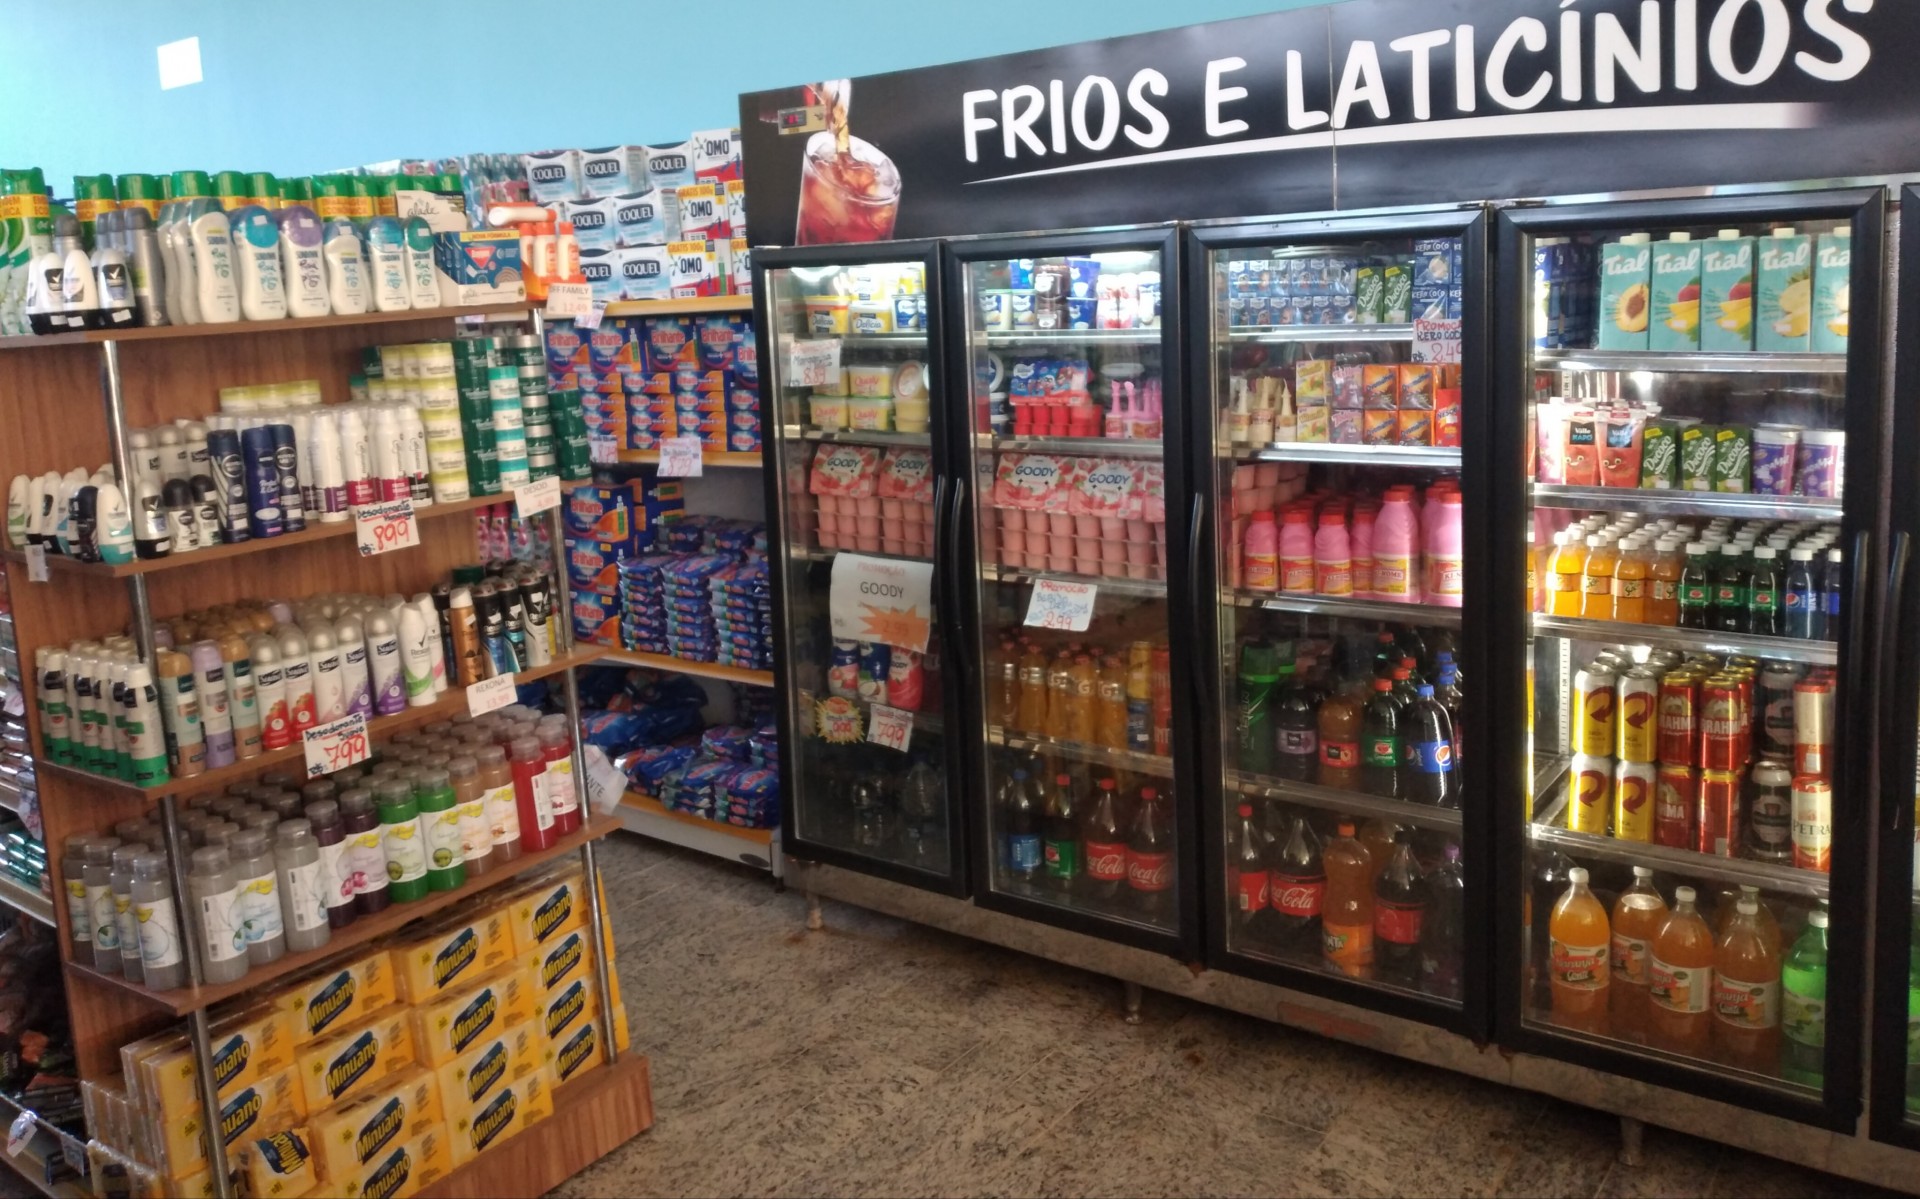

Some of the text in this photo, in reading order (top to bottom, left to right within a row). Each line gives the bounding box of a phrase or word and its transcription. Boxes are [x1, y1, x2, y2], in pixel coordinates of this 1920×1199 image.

[963, 0, 1871, 163] FRIOS E LATICÍNIOS
[706, 138, 729, 156] OMO
[584, 159, 620, 175] COQUEL
[650, 155, 687, 173] COQUEL
[531, 165, 567, 182] COQUEL
[617, 204, 653, 222] COQUEL
[690, 200, 713, 218] OMO
[570, 212, 605, 228] COQUEL
[1818, 244, 1850, 267] Tia
[622, 261, 661, 278] COQUEL
[680, 258, 702, 274] OMO
[1417, 331, 1441, 341] KERO
[827, 458, 861, 468] GOODY
[895, 459, 928, 471] GOODY
[1015, 465, 1057, 477] GOODY
[1088, 473, 1130, 485] GOODY
[860, 581, 904, 599] GOODY
[476, 678, 506, 694] REXONA
[1793, 820, 1831, 836] PETRA
[531, 890, 573, 943] Minuano
[433, 934, 479, 988] Minuano
[542, 940, 584, 988] Minuano
[306, 976, 357, 1032] Minuano
[546, 986, 587, 1037] Minuano
[451, 995, 498, 1053] Minuano
[214, 1041, 250, 1081] nuano
[555, 1029, 597, 1079] Minuano
[325, 1038, 379, 1097] Minuano
[468, 1047, 509, 1102] Minuano
[222, 1095, 263, 1138] nuano
[470, 1093, 518, 1151] Minuano
[356, 1102, 405, 1162] Minuano
